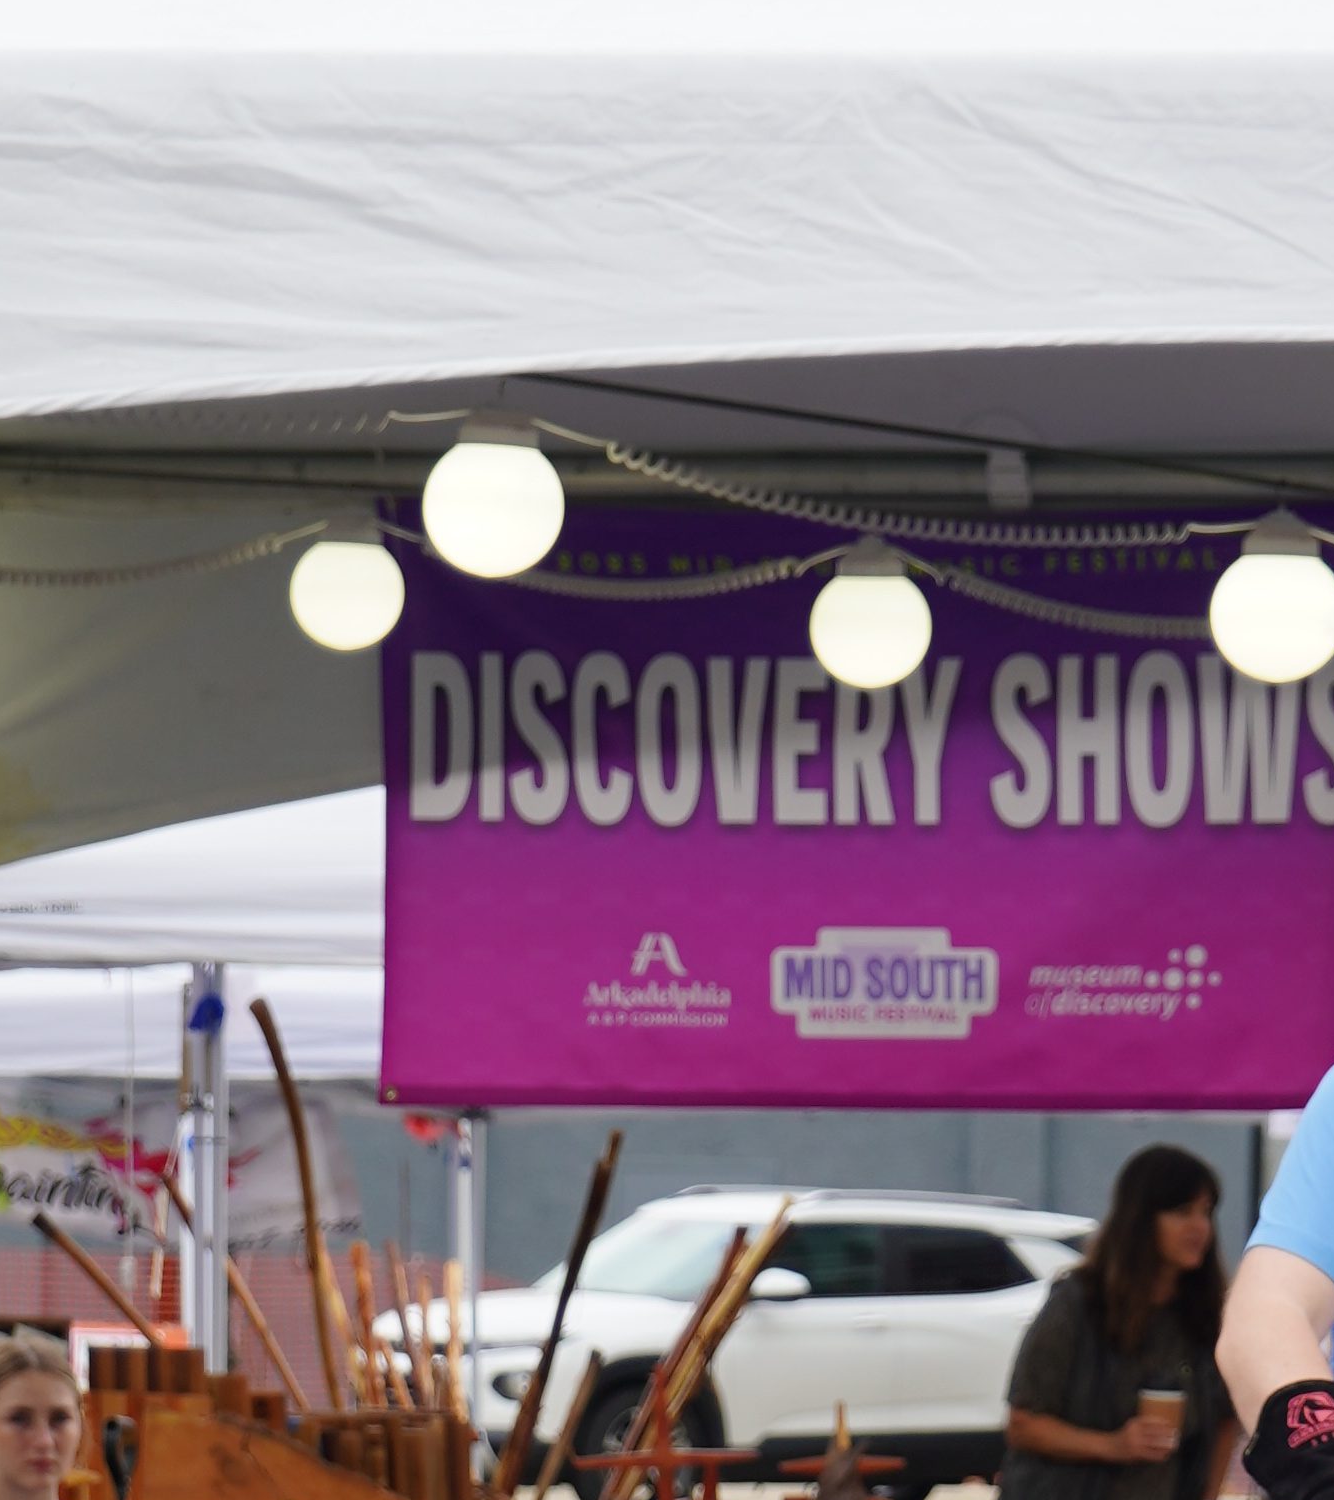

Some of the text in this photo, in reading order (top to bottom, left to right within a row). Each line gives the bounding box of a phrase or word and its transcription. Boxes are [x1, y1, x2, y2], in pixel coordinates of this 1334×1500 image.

[1044, 548, 1215, 577] FESTIVAL
[409, 650, 962, 827] DISCOVERY
[785, 957, 986, 1000] MID SOUTH
[1028, 965, 1144, 987] museum
[583, 980, 732, 1011] Arkadelphia
[1051, 988, 1183, 1021] discovery
[630, 1011, 729, 1028] COMMISSION
[808, 1005, 959, 1024] MUSIC FESTIVAL
